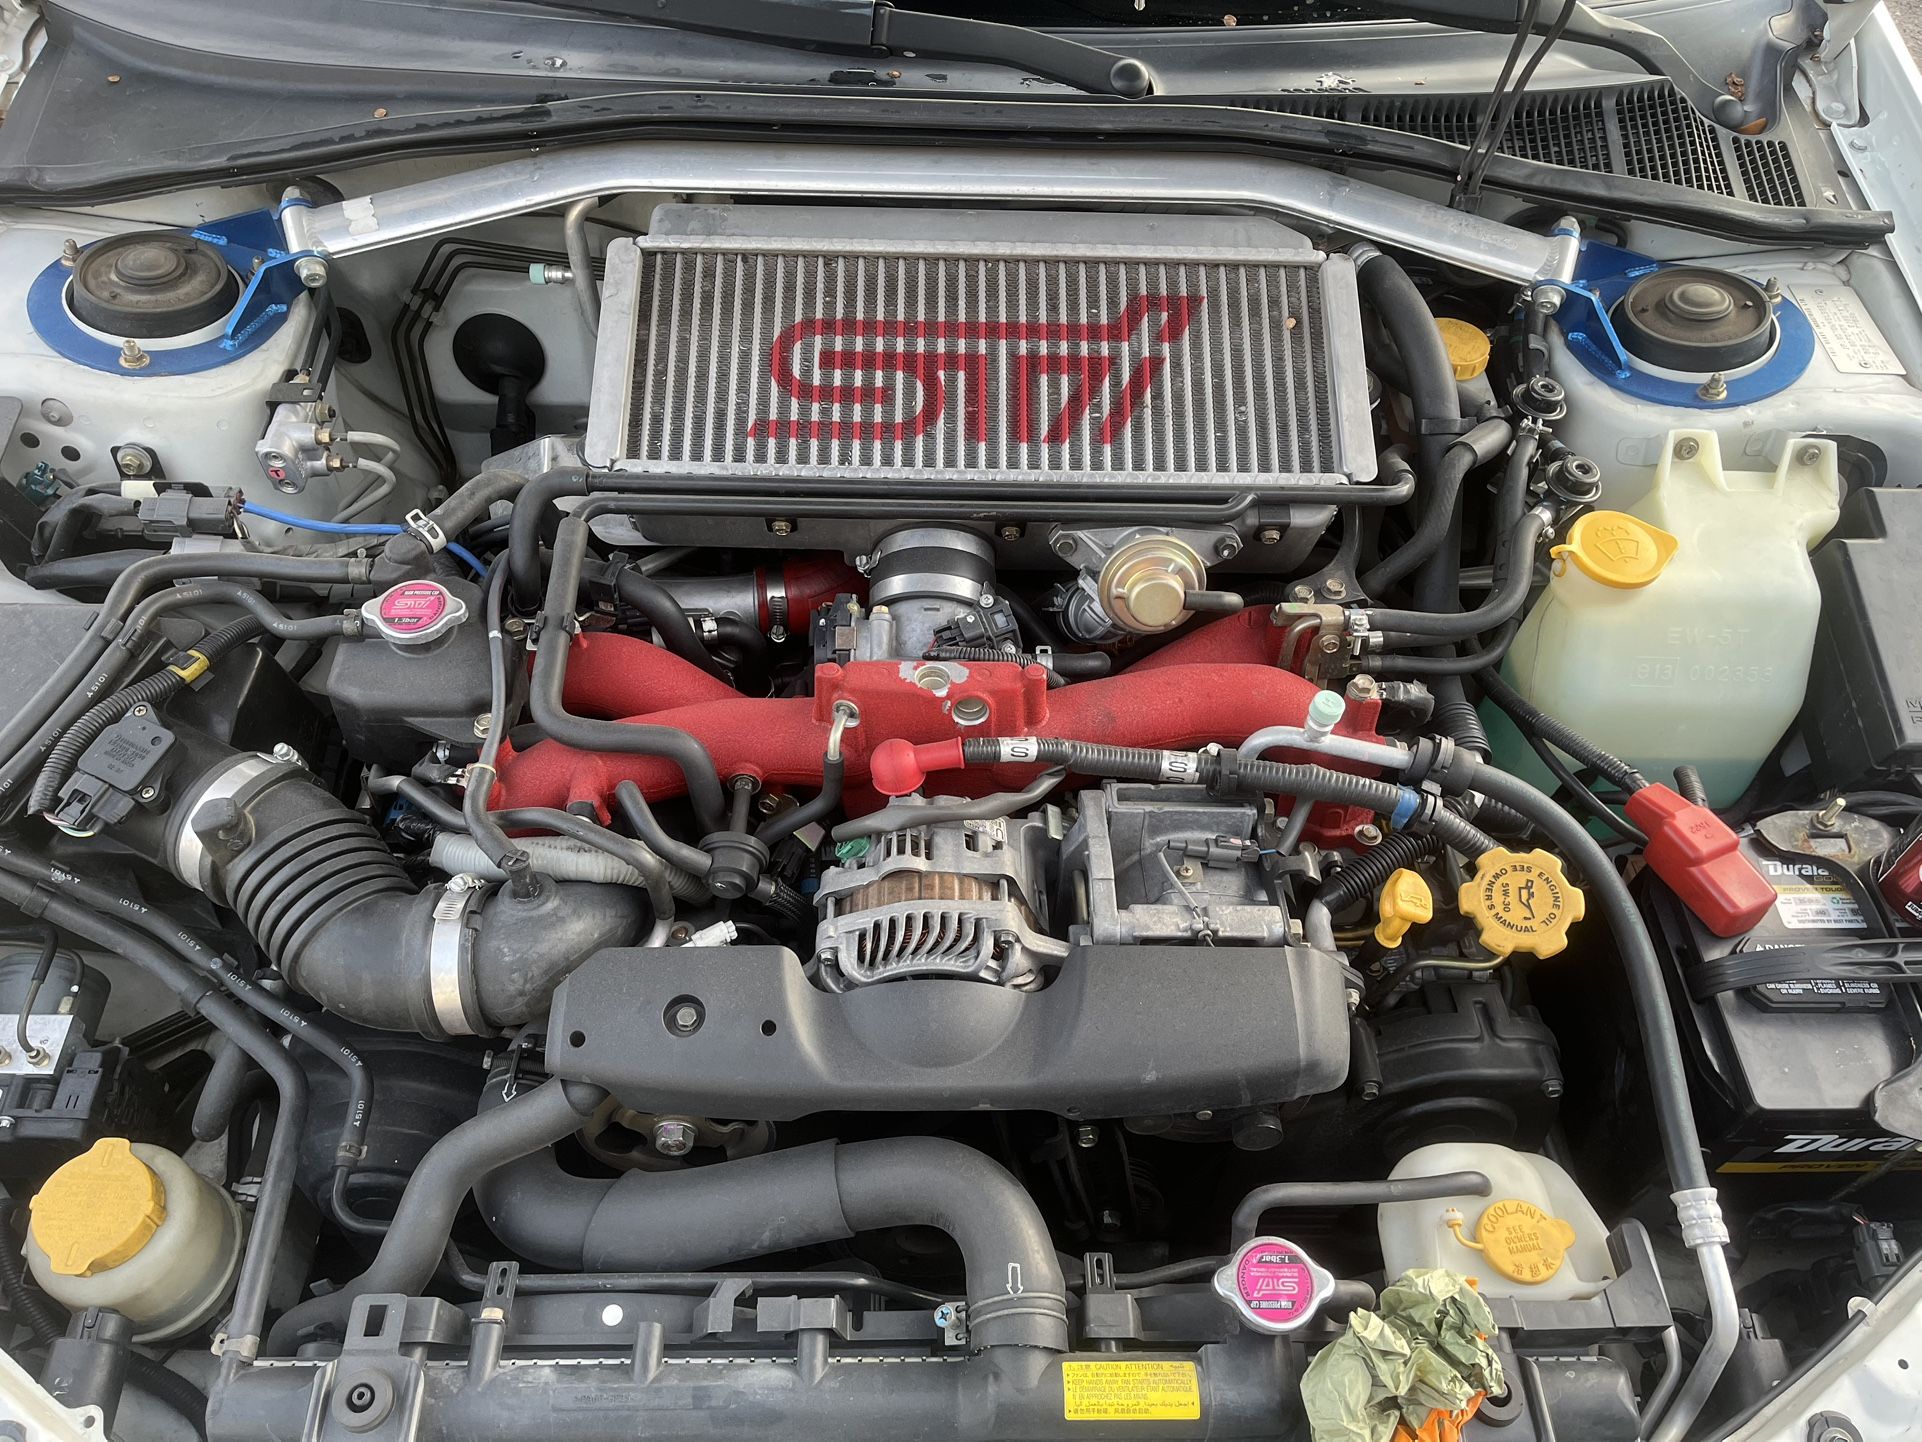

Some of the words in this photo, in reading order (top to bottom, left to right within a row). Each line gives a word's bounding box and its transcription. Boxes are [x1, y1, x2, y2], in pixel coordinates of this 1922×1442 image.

[1510, 864, 1533, 873] SEE
[1762, 861, 1829, 876] Durala
[1485, 867, 1508, 911] OWNER'S
[1537, 872, 1561, 910] ENGINE
[1493, 911, 1537, 933] MANUAL
[1540, 912, 1557, 927] OIL
[1483, 1202, 1547, 1233] COOLANT
[1505, 1224, 1525, 1236] SEE
[1505, 1232, 1539, 1246] OWNERS
[1508, 1242, 1543, 1256] MANUAL
[1261, 1255, 1289, 1263] 1.3bar
[1239, 1259, 1251, 1298] DANGER
